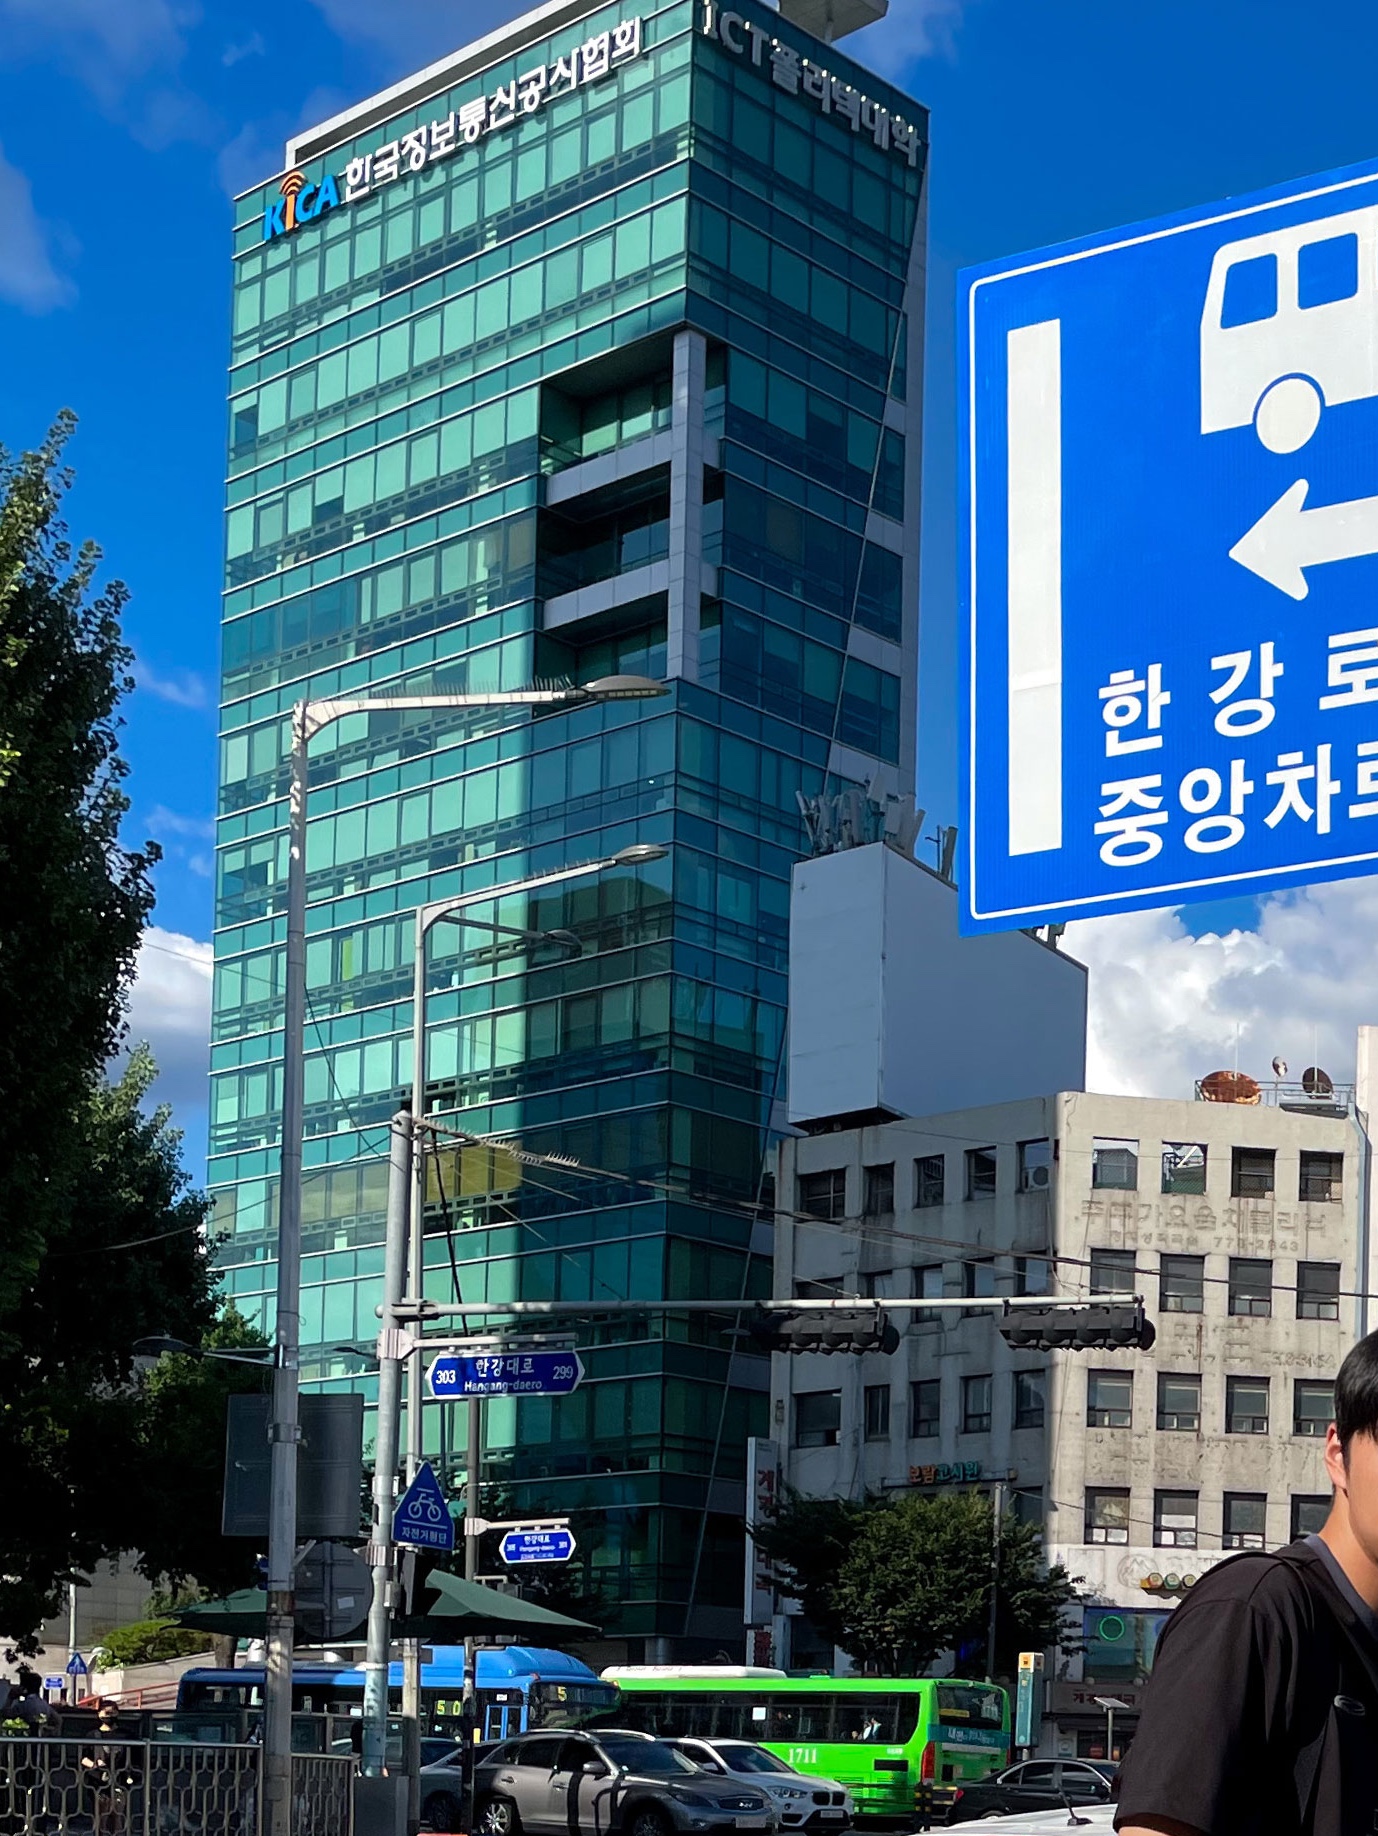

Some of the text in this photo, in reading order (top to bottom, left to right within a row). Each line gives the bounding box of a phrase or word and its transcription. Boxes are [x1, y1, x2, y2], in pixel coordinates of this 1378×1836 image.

[475, 1358, 535, 1378] 한강대로
[552, 1366, 574, 1380] 299
[435, 1370, 456, 1385] 303
[464, 1380, 543, 1393] Hangang-daero
[787, 1747, 818, 1764] 1711
